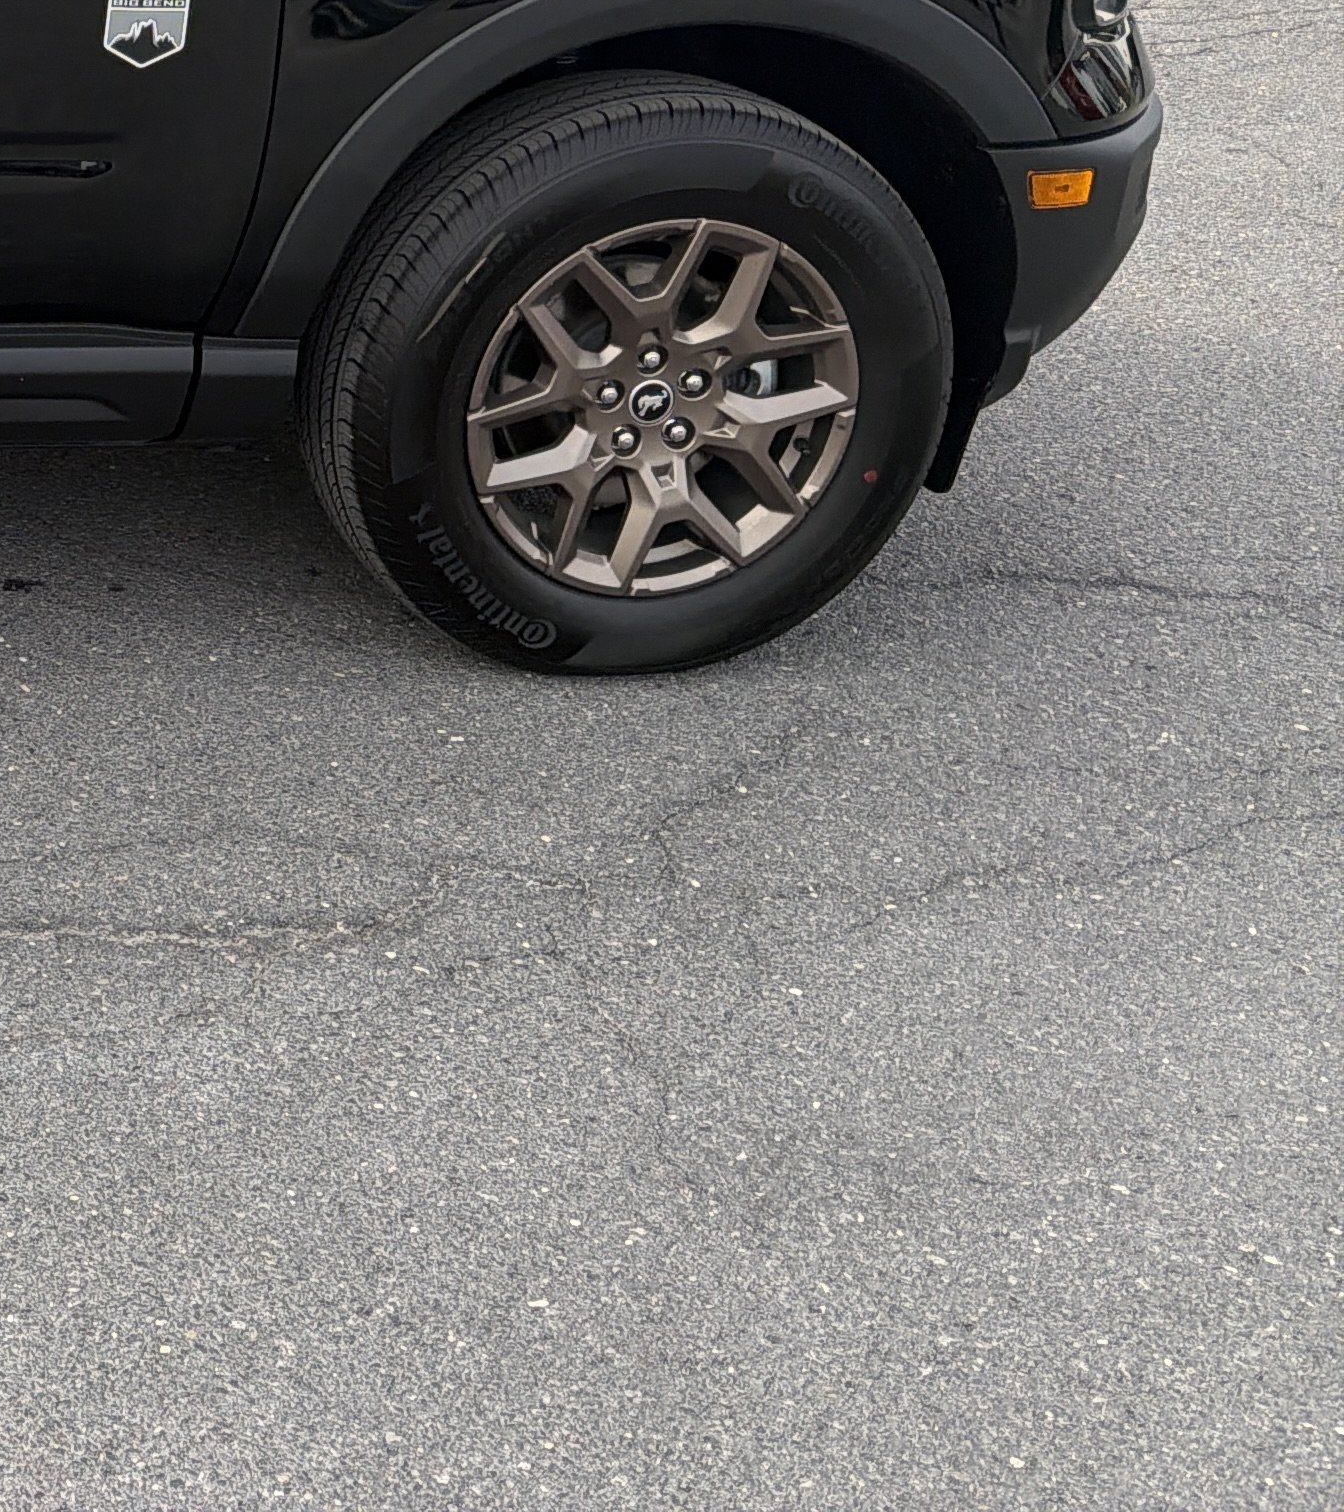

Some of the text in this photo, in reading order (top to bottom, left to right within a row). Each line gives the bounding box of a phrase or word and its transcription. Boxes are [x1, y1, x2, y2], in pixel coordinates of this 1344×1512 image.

[112, 0, 185, 7] BIG BEND
[414, 525, 558, 650] Continental
